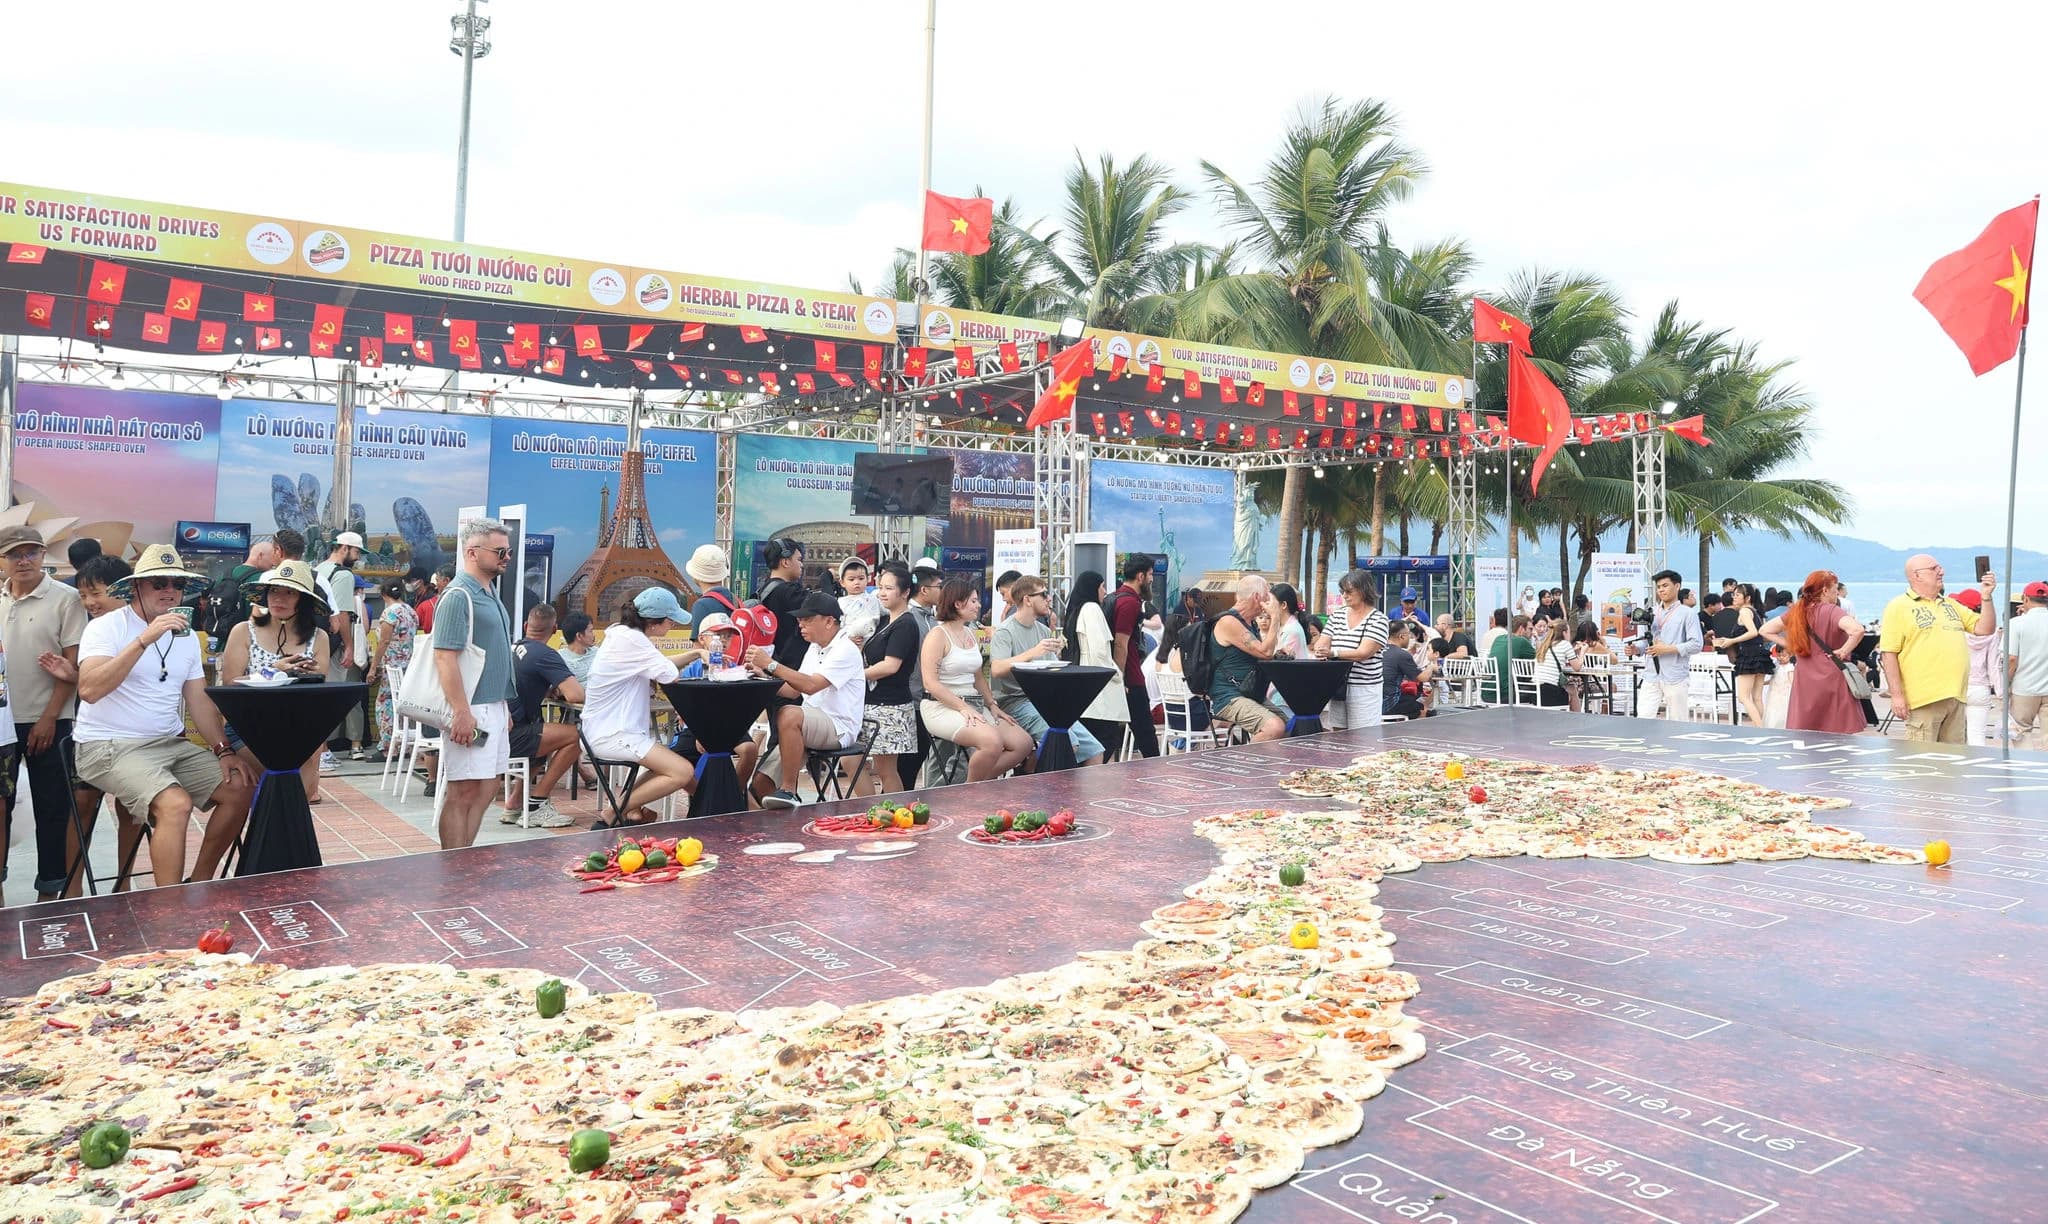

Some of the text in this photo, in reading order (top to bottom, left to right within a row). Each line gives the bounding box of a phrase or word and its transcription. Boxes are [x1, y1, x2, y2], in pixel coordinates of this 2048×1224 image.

[25, 199, 151, 230] SATISFACTION
[158, 216, 219, 238] DRIVES
[40, 223, 157, 252] US FORWARD
[370, 243, 424, 268] PIZZA
[430, 251, 471, 274] TƯƠI
[477, 256, 537, 283] NƯỚNG
[543, 262, 572, 287] CỦI
[419, 274, 513, 295] WOOD FIRED PIZZA
[680, 285, 741, 309] HERBAL
[747, 293, 790, 315] PIZZA
[794, 299, 806, 317] &
[812, 301, 857, 322] STEAK
[1172, 348, 1192, 361] YOUR
[1196, 352, 1248, 368] SATISFACTION
[1251, 357, 1278, 372] DRIVES
[1202, 366, 1212, 378] US
[1344, 370, 1369, 385] PIZZA
[43, 412, 78, 434] HÌNH
[83, 416, 114, 436] NHÀ
[119, 418, 147, 438] HÁT
[151, 423, 179, 440] CON
[184, 421, 203, 441] SÒ
[247, 414, 267, 435] LÒ
[272, 417, 324, 439] NƯỚNG
[359, 420, 393, 444] HÌNH
[431, 425, 467, 449] VÀNG
[25, 438, 53, 449] OPERA
[56, 439, 84, 450] HOUSE
[88, 441, 121, 453] SHAPED
[124, 444, 146, 454] OVEN
[293, 443, 328, 455] GOLDEN
[403, 449, 425, 461] OVEN
[514, 432, 696, 461] LÒ NƯỚNG MÔ HÌNH ÁP EIFFEL
[552, 458, 576, 469] EIFFEL
[816, 461, 835, 476] HÌNH
[787, 477, 853, 491] COLOSSEUM-SHA
[998, 476, 1014, 494] MÔ
[208, 530, 241, 541] pepsi
[524, 538, 544, 546] epsi
[961, 552, 981, 561] pepsi
[1594, 887, 1670, 907] Thanh
[1733, 884, 1796, 899] Ninh
[1470, 921, 1509, 934] Hà
[1578, 914, 1617, 928] An
[1500, 977, 1657, 1020] Quảng Trị
[1489, 1046, 1807, 1152] Thừa Thiên Huế
[1486, 1125, 1675, 1200] Đà Nẵng
